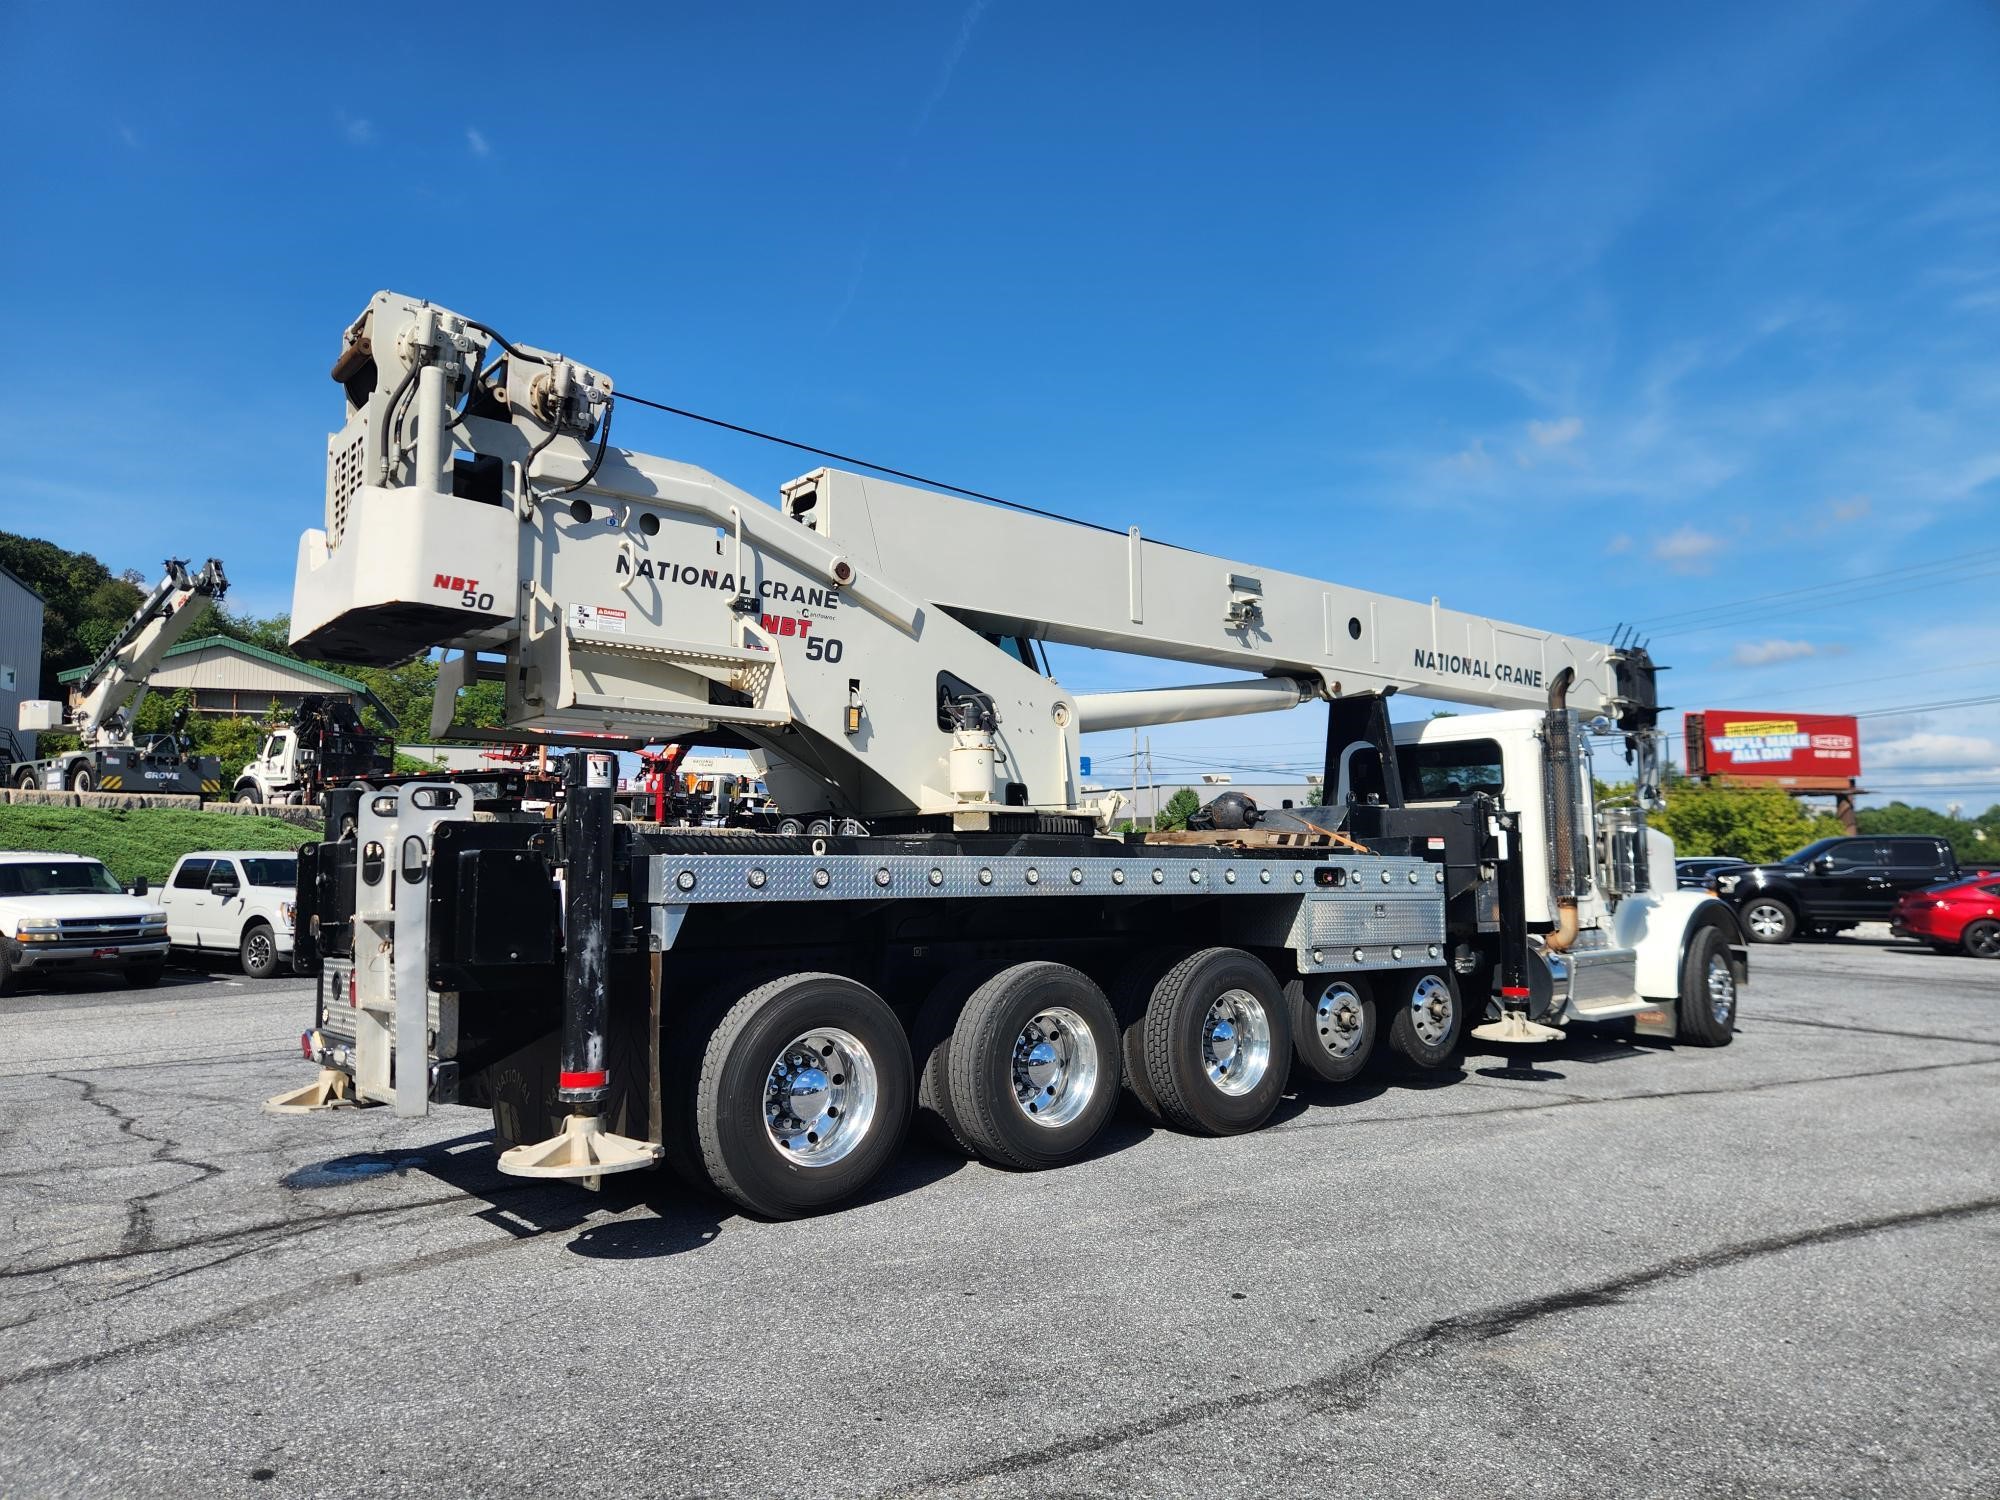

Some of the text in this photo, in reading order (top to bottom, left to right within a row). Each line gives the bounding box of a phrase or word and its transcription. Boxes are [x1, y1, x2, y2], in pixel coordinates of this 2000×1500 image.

[433, 574, 479, 592] NBT
[616, 554, 840, 609] NATIONAL CRANE
[461, 590, 494, 611] 50
[761, 613, 812, 639] NBT
[806, 636, 843, 664] 50
[1414, 648, 1542, 688] NATIONAL CRANE
[1732, 747, 1793, 762] ALL DAY
[144, 771, 180, 780] GROVE
